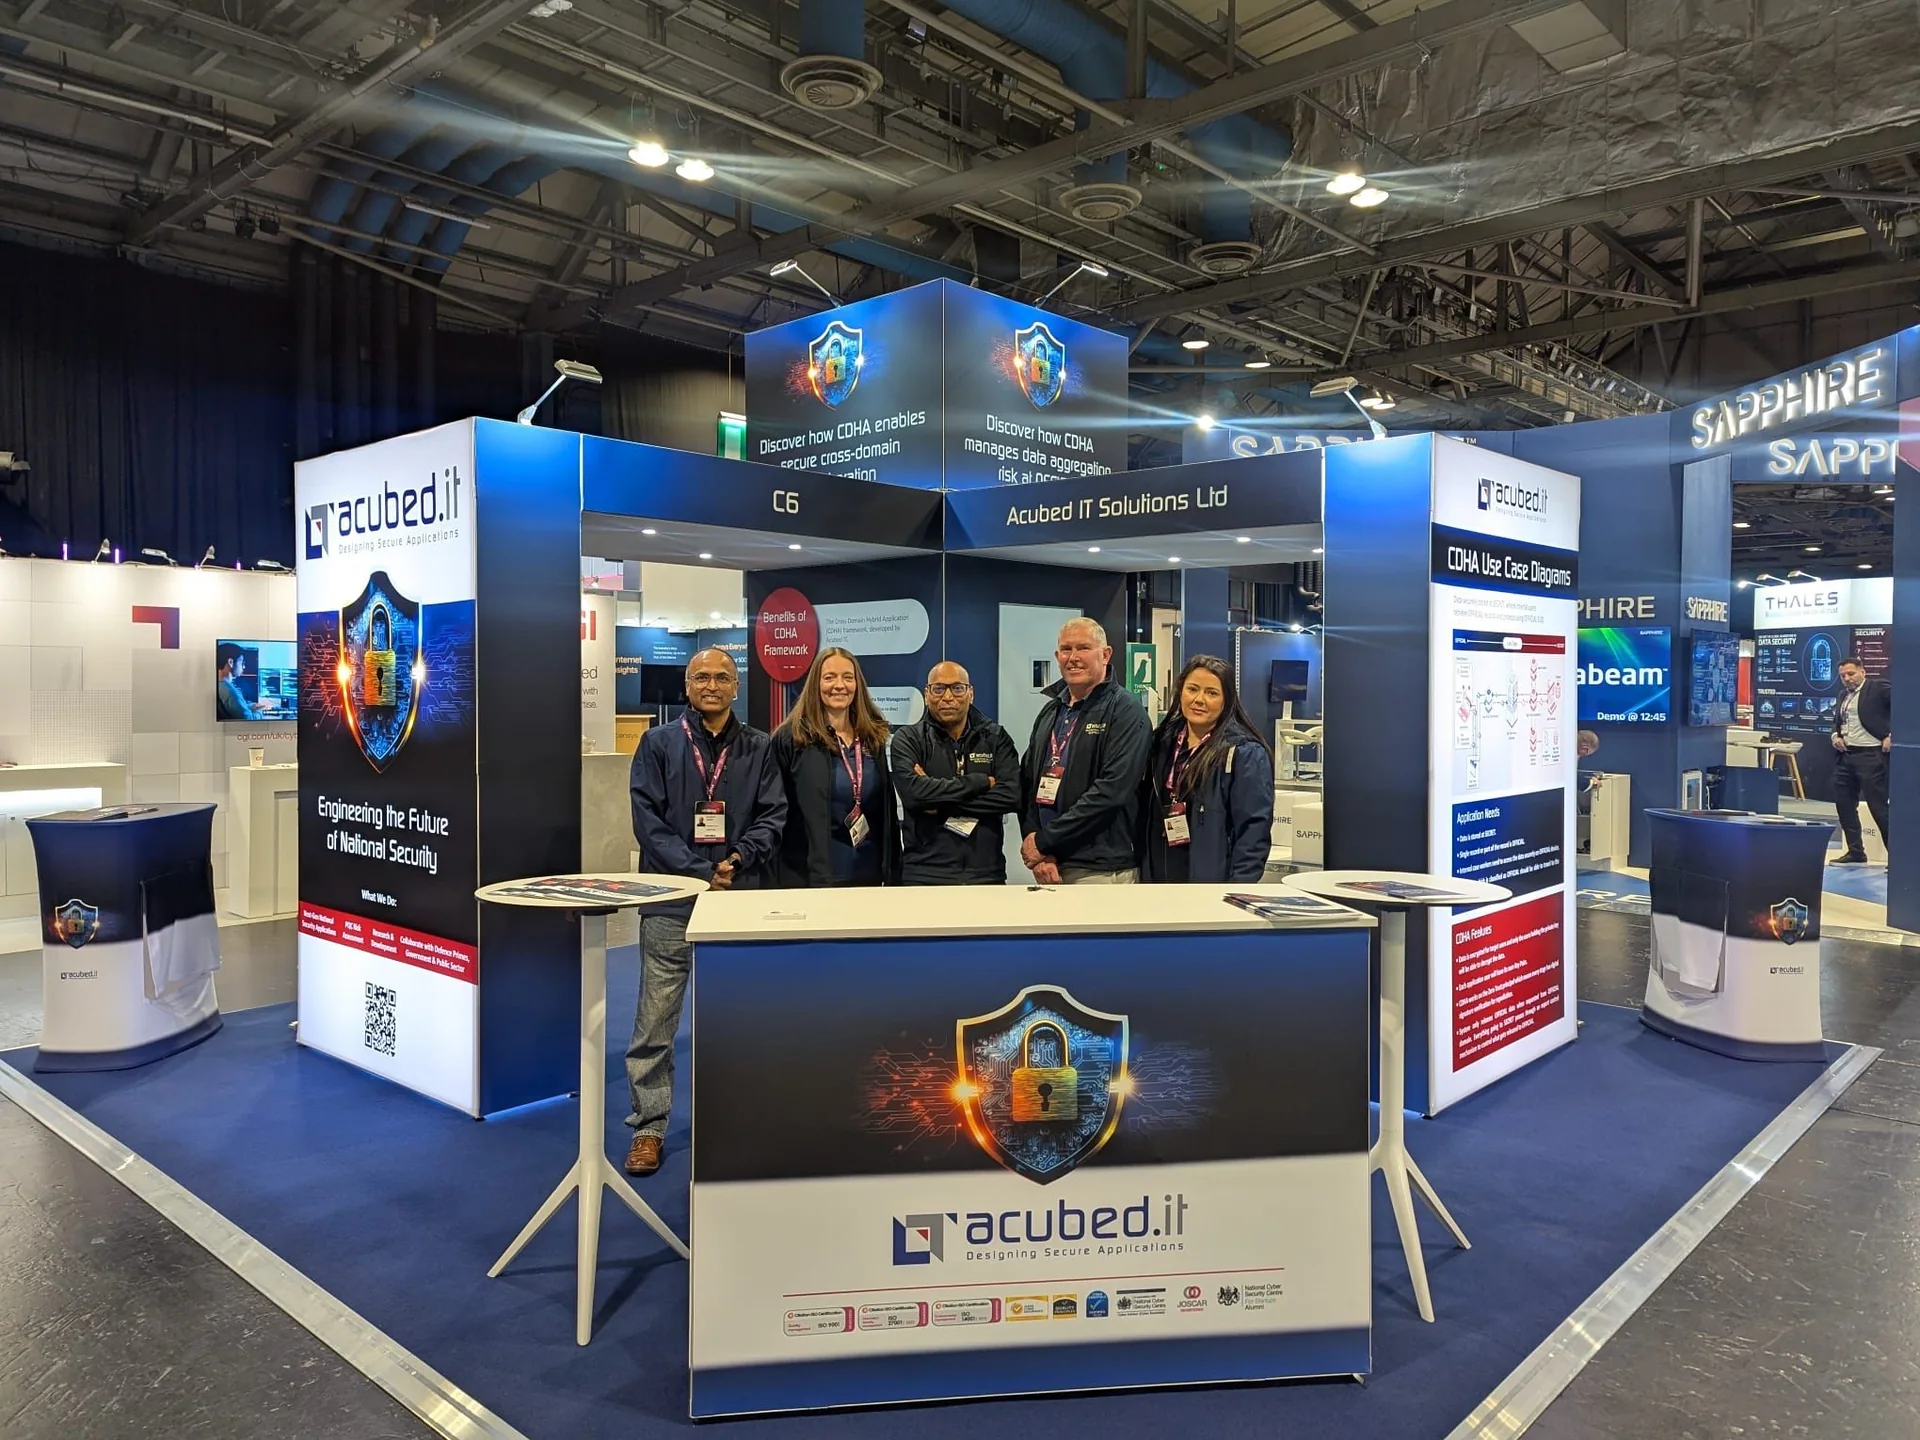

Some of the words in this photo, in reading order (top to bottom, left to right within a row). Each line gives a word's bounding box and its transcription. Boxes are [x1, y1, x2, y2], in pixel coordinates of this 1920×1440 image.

[1692, 348, 1882, 449] SAPPHIRE
[760, 433, 806, 454] Discover
[808, 426, 835, 446] how
[837, 421, 872, 441] CDHA
[875, 410, 926, 432] enables
[986, 414, 1036, 440] Discover
[1038, 421, 1061, 446] how
[1064, 433, 1094, 454] CDHA
[781, 456, 818, 470] secure
[820, 438, 901, 466] cross-domain
[964, 438, 1019, 460] manages
[1022, 448, 1046, 466] data
[1050, 455, 1112, 476] aggregation
[998, 466, 1018, 484] risk
[1022, 470, 1032, 484] at
[338, 465, 461, 537] acubed.it
[772, 490, 800, 514] C6
[1006, 504, 1072, 526] Acubed
[1078, 500, 1093, 518] IT
[1098, 490, 1188, 518] Solutions
[1196, 484, 1228, 508] Ltd
[1495, 482, 1548, 514] acubed.it
[338, 540, 375, 554] Designing
[378, 537, 402, 549] Secure
[406, 528, 459, 546] Applications
[1448, 546, 1480, 575] CDHA
[1482, 551, 1502, 578] Use
[1504, 556, 1529, 581] Case
[1530, 560, 1571, 588] Diagrams
[1686, 596, 1728, 622] SAPPHIRE
[1765, 592, 1838, 610] THALES
[763, 611, 796, 624] Benefits
[798, 610, 806, 622] of
[774, 627, 798, 640] CDHA
[764, 644, 808, 656] Framework
[1598, 712, 1626, 722] Demo
[1628, 712, 1638, 722] @
[1640, 712, 1666, 722] 12:45
[318, 795, 382, 830] Engineering
[386, 804, 406, 829] the
[408, 808, 449, 836] Future
[1457, 810, 1484, 825] Application
[1485, 808, 1500, 818] Needs
[327, 831, 338, 851] of
[340, 834, 386, 860] National
[389, 840, 438, 875] Security
[361, 889, 376, 903] What
[377, 892, 387, 905] We
[387, 894, 397, 908] Do:
[371, 939, 397, 953] Development
[372, 928, 390, 939] Research
[1456, 930, 1470, 944] CDHA
[1471, 925, 1492, 940] Features
[400, 936, 424, 949] Collaborate
[424, 942, 434, 951] with
[434, 945, 452, 956] Defence
[452, 950, 470, 963] Primes,
[405, 949, 432, 963] Government
[436, 957, 449, 968] Public
[450, 962, 465, 972] Sector
[966, 1194, 1188, 1245] acubed.it
[966, 1249, 1037, 1262] Designing
[1044, 1246, 1091, 1258] Secure
[1098, 1242, 1184, 1256] Applications
